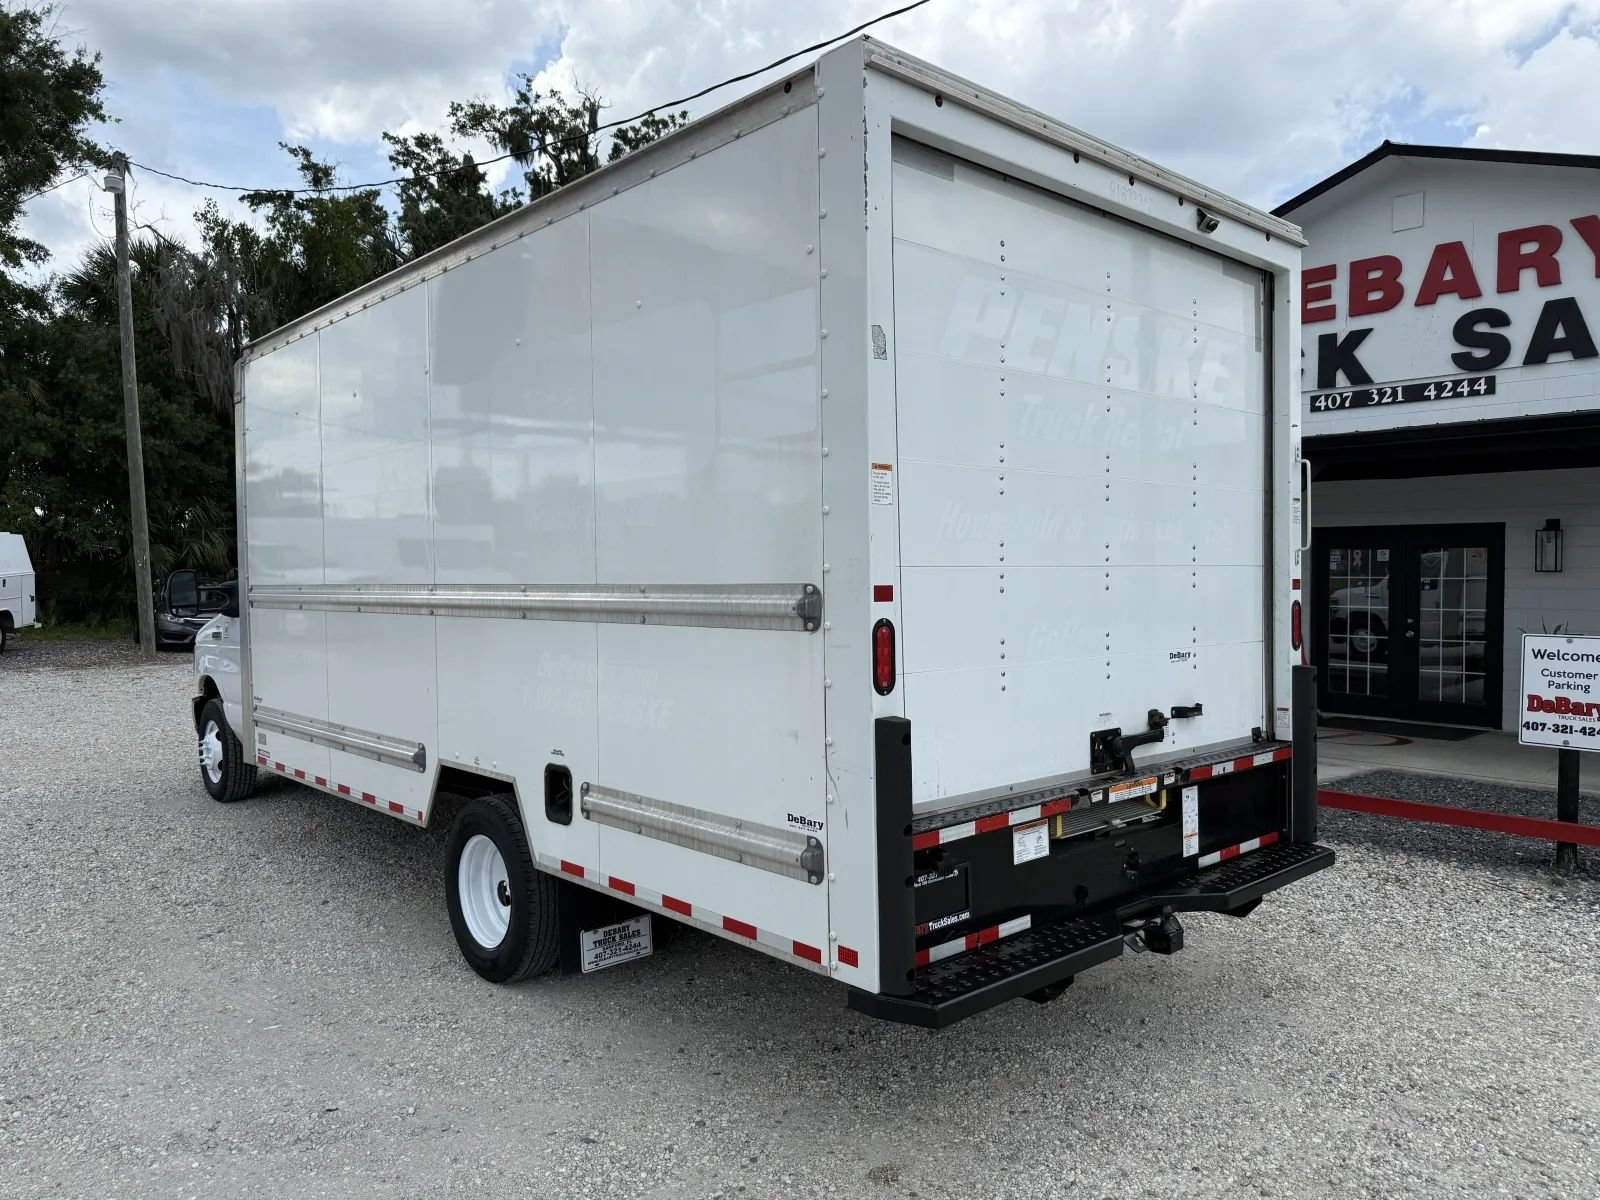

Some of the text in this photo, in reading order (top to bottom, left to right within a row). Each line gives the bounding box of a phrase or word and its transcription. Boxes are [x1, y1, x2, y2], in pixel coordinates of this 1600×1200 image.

[1300, 296, 1599, 389] K SA
[1315, 377, 1487, 411] 407 321 4244
[1531, 648, 1600, 663] Welcome
[1540, 668, 1599, 681] Customer
[1547, 680, 1591, 694] Parking
[787, 813, 824, 831] DeBary
[593, 929, 641, 948] TRUCK SALES
[594, 941, 642, 960] 407-321-4244
